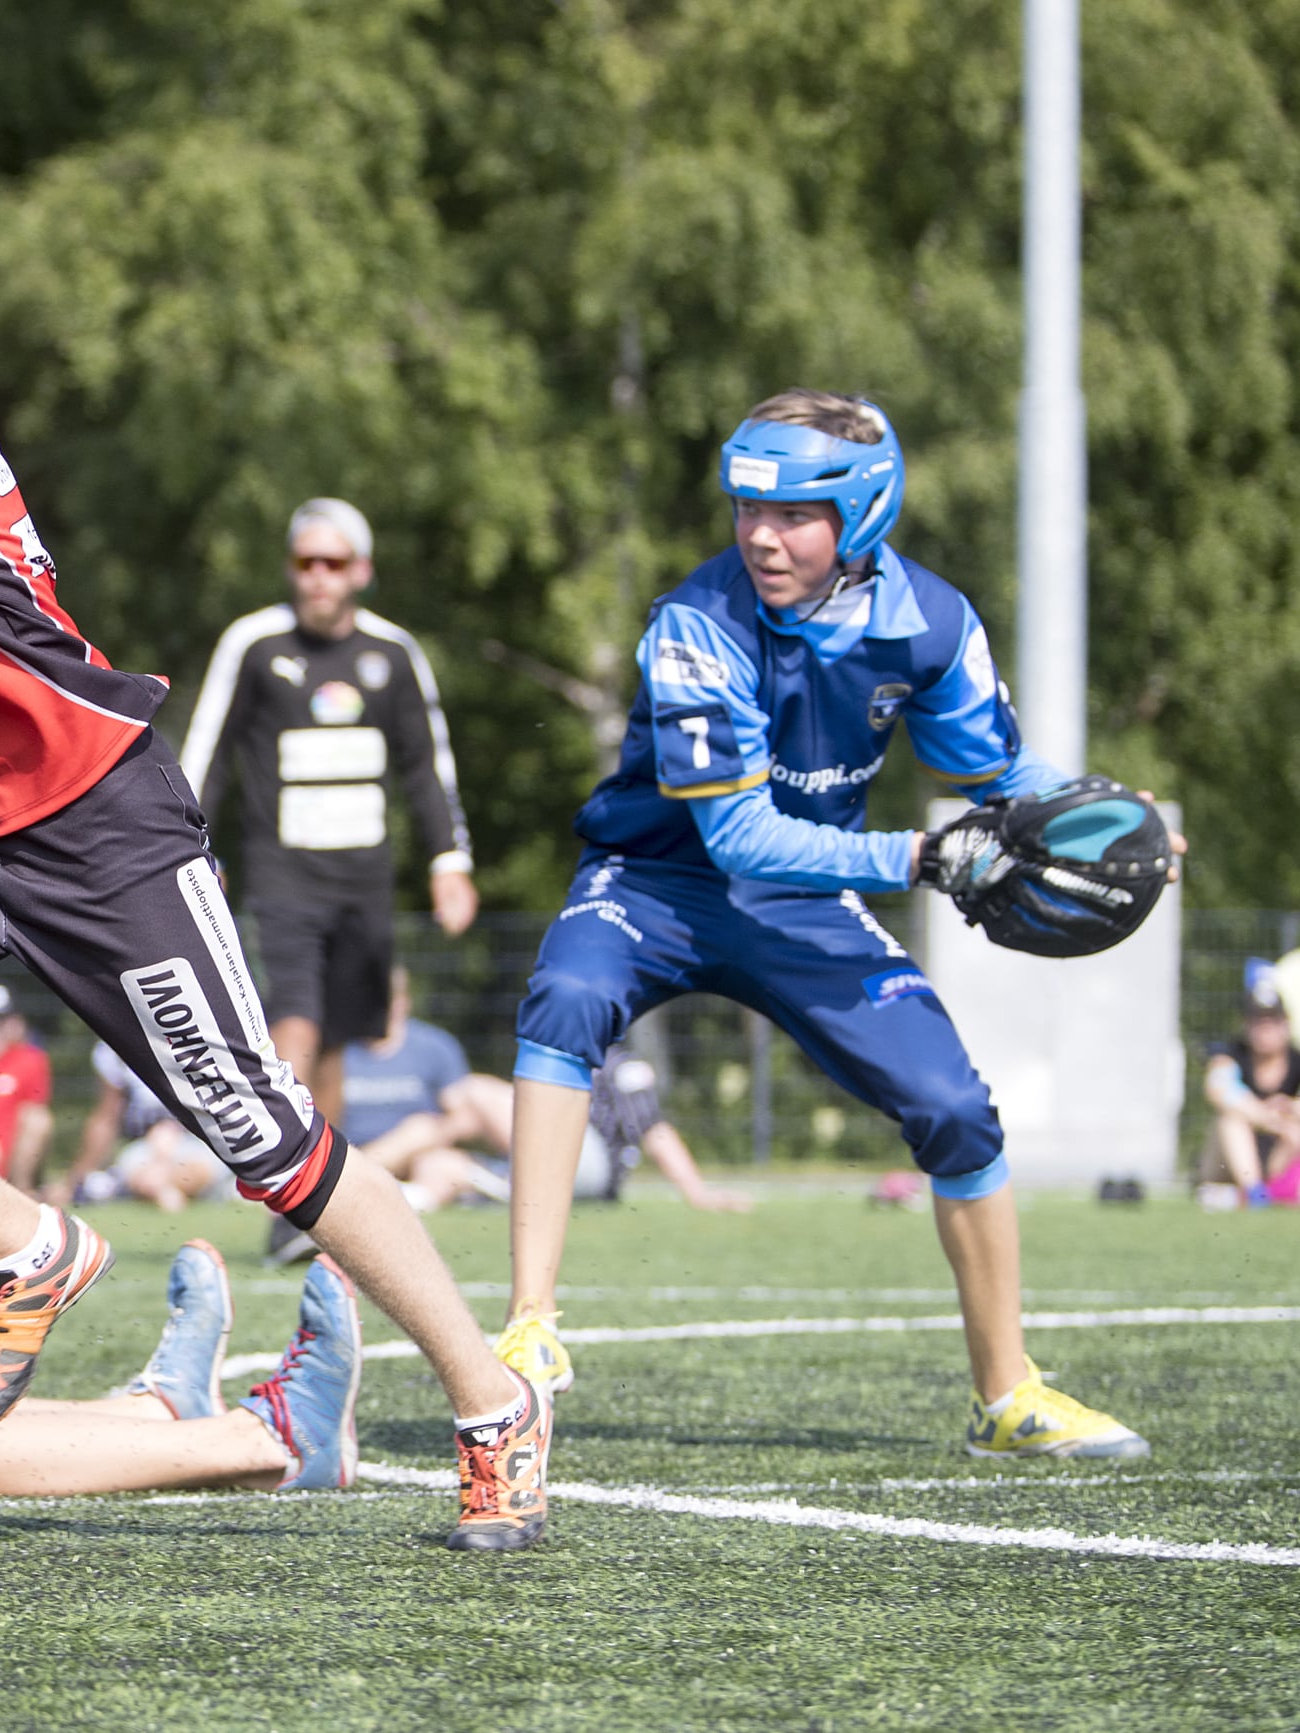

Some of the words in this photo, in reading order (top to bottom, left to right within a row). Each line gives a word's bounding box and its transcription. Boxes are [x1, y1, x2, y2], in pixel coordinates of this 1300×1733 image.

[678, 715, 711, 770] 7
[185, 867, 229, 951] ammattiopisto
[224, 951, 264, 1044] Pohjois-Karjalan
[136, 968, 265, 1155] KITEENHOVI
